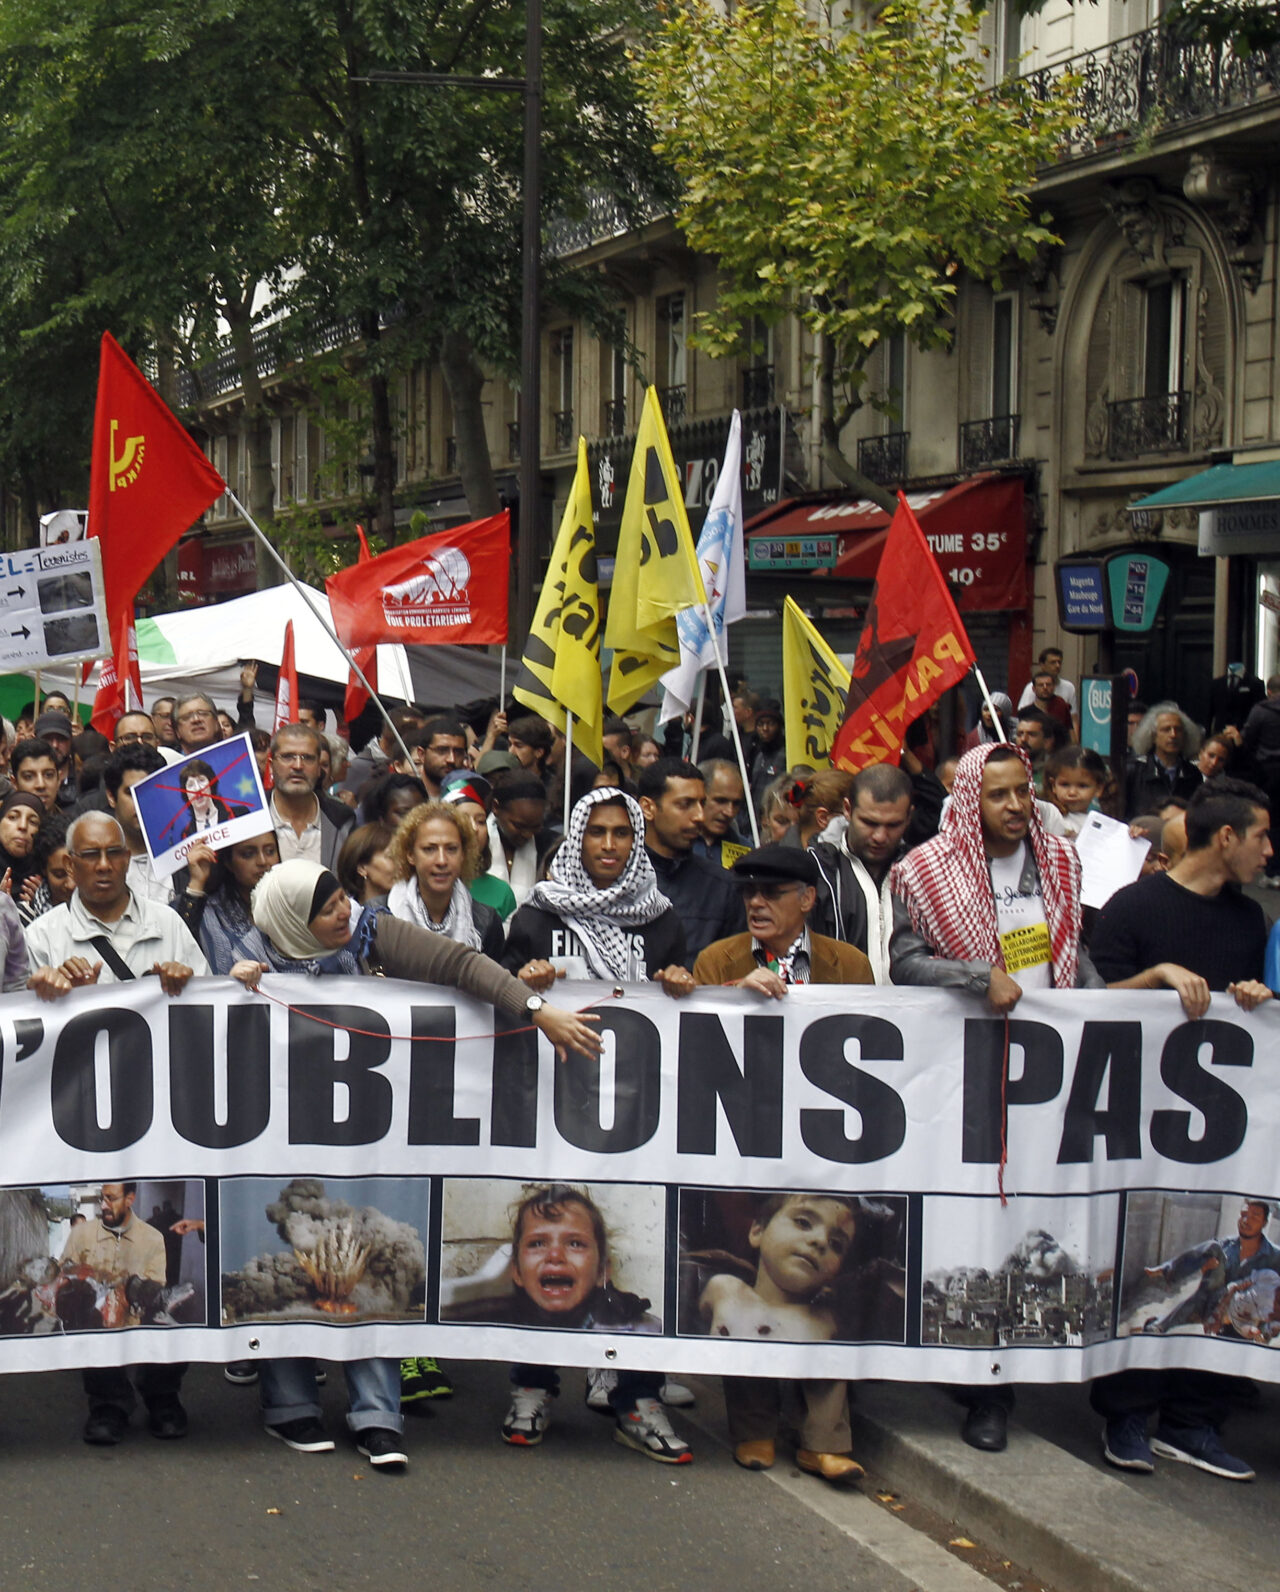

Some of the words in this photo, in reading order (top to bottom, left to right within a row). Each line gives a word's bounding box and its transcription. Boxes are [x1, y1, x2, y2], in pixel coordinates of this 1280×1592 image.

[1217, 514, 1279, 534] HOMMES
[1070, 577, 1095, 588] Magenta
[1069, 591, 1098, 601] Maubeuge
[1067, 604, 1080, 614] Gare
[1081, 604, 1088, 614] du
[1089, 604, 1104, 614] Nord
[1092, 689, 1112, 708] BUS
[1004, 927, 1036, 941] STOP
[962, 1017, 1255, 1165] PAS
